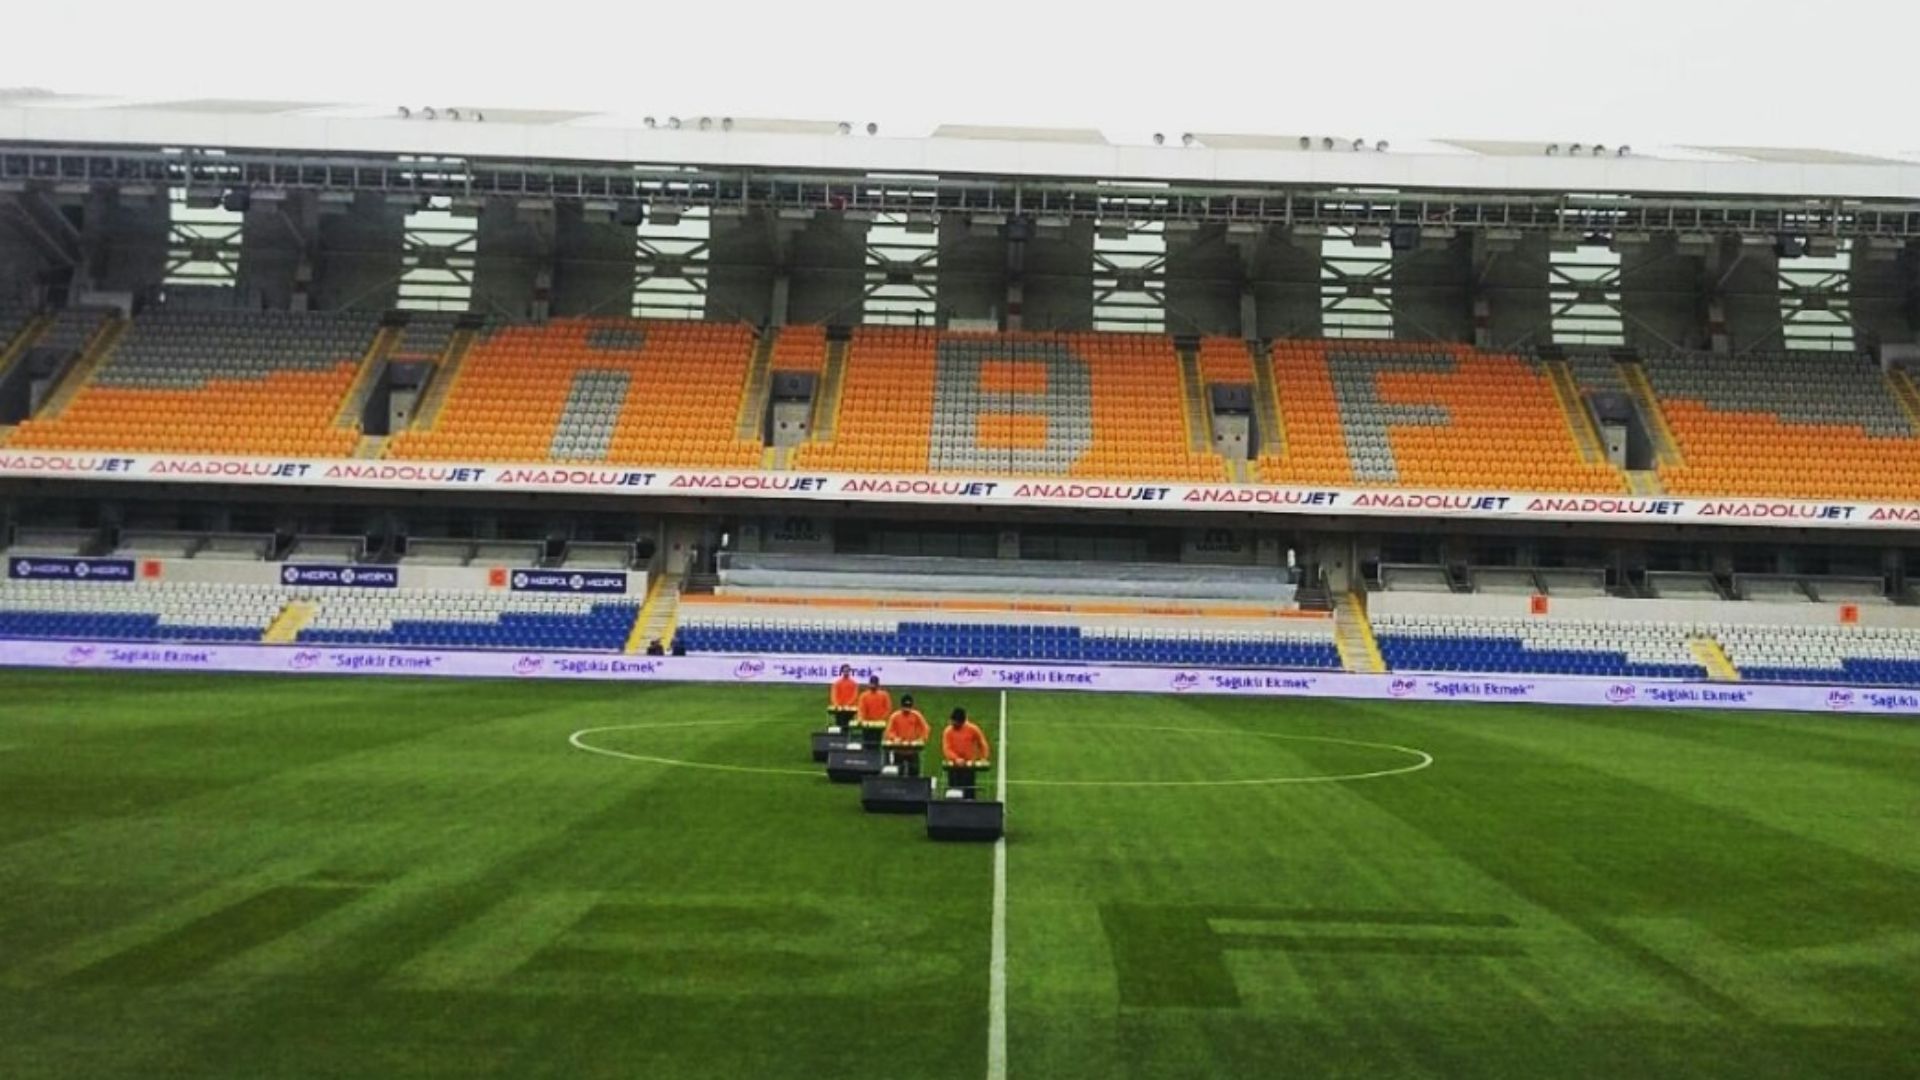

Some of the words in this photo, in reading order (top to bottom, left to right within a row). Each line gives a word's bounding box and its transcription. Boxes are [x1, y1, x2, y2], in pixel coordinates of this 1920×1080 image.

[150, 461, 311, 477] ANADOLUJET
[325, 466, 485, 481] ANADOLUJET
[495, 470, 656, 486] ANADOLUJET
[669, 475, 827, 491] ANADOLUJET
[840, 480, 998, 496] ANADOLUJET
[1013, 485, 1171, 500] ANADOLUJET
[1182, 490, 1340, 505] ANADOLUJET
[1351, 494, 1510, 510] ANADOLUJET
[1526, 499, 1685, 514] ANADOLUJET
[1696, 503, 1856, 519] ANADOLUJET
[831, 665, 882, 677] Emek"
